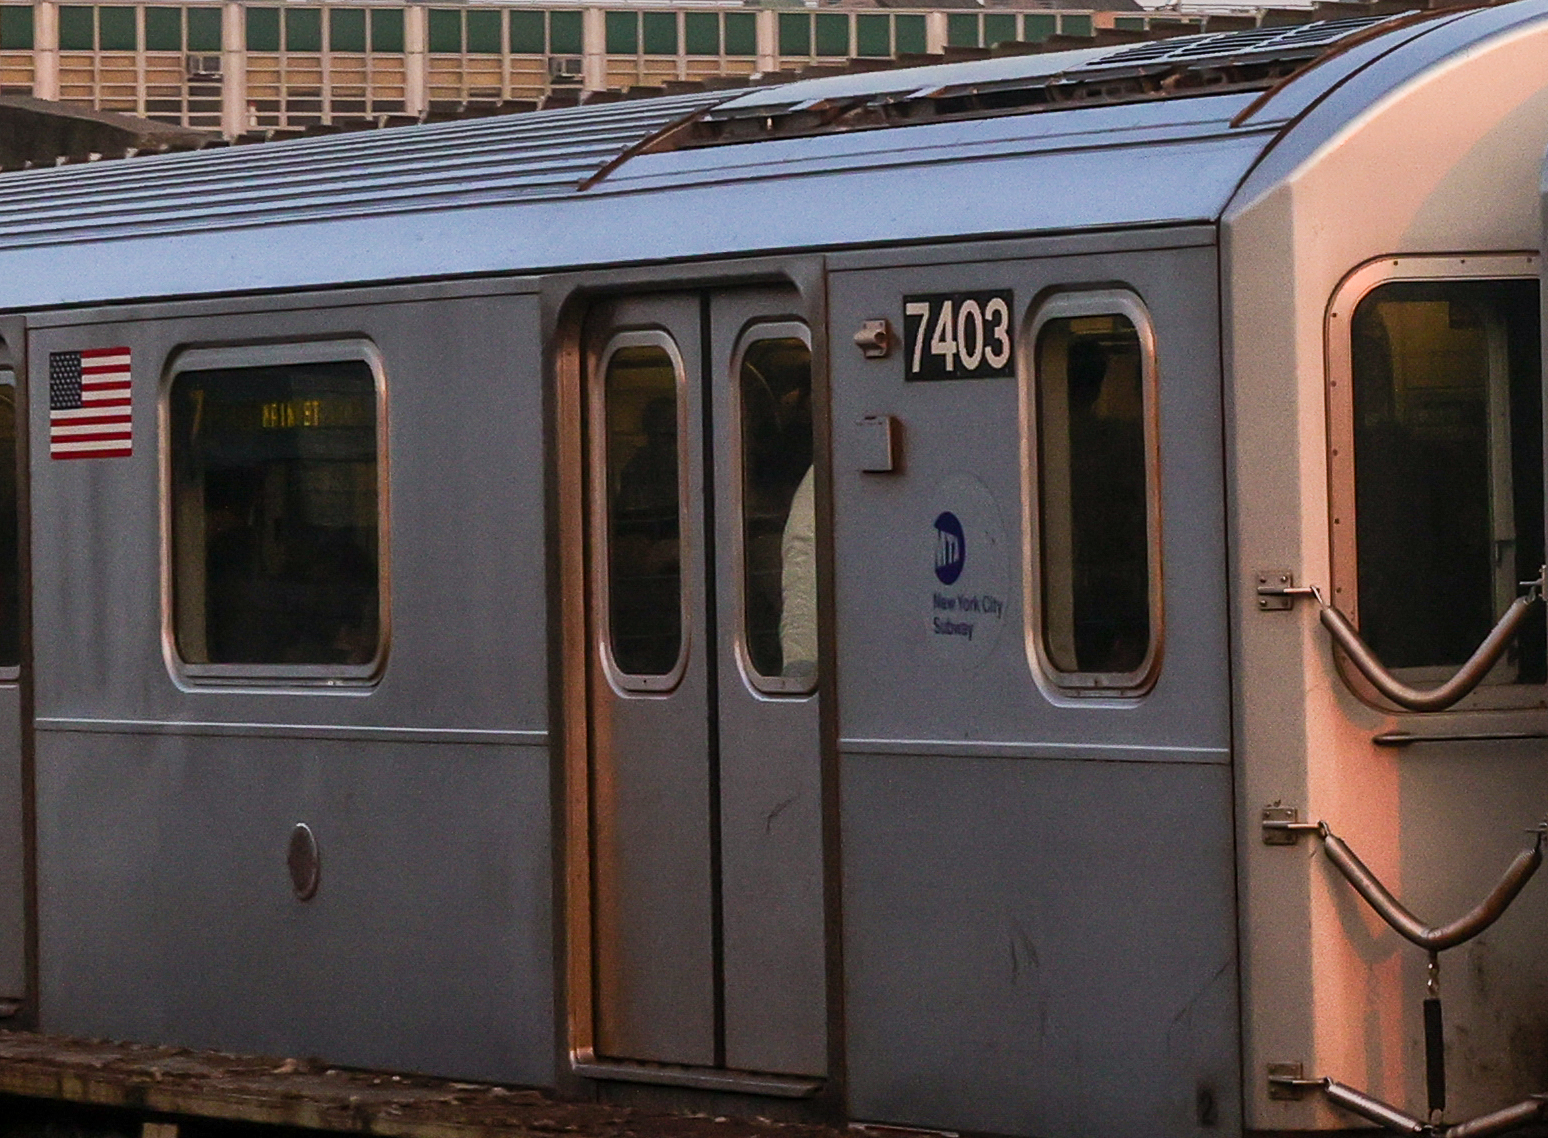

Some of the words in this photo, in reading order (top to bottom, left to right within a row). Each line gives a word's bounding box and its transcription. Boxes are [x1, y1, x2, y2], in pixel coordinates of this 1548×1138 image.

[905, 297, 1011, 373] 7403
[933, 593, 955, 610] New
[957, 594, 980, 612] York
[982, 594, 1003, 619] City
[933, 616, 974, 641] Subway
